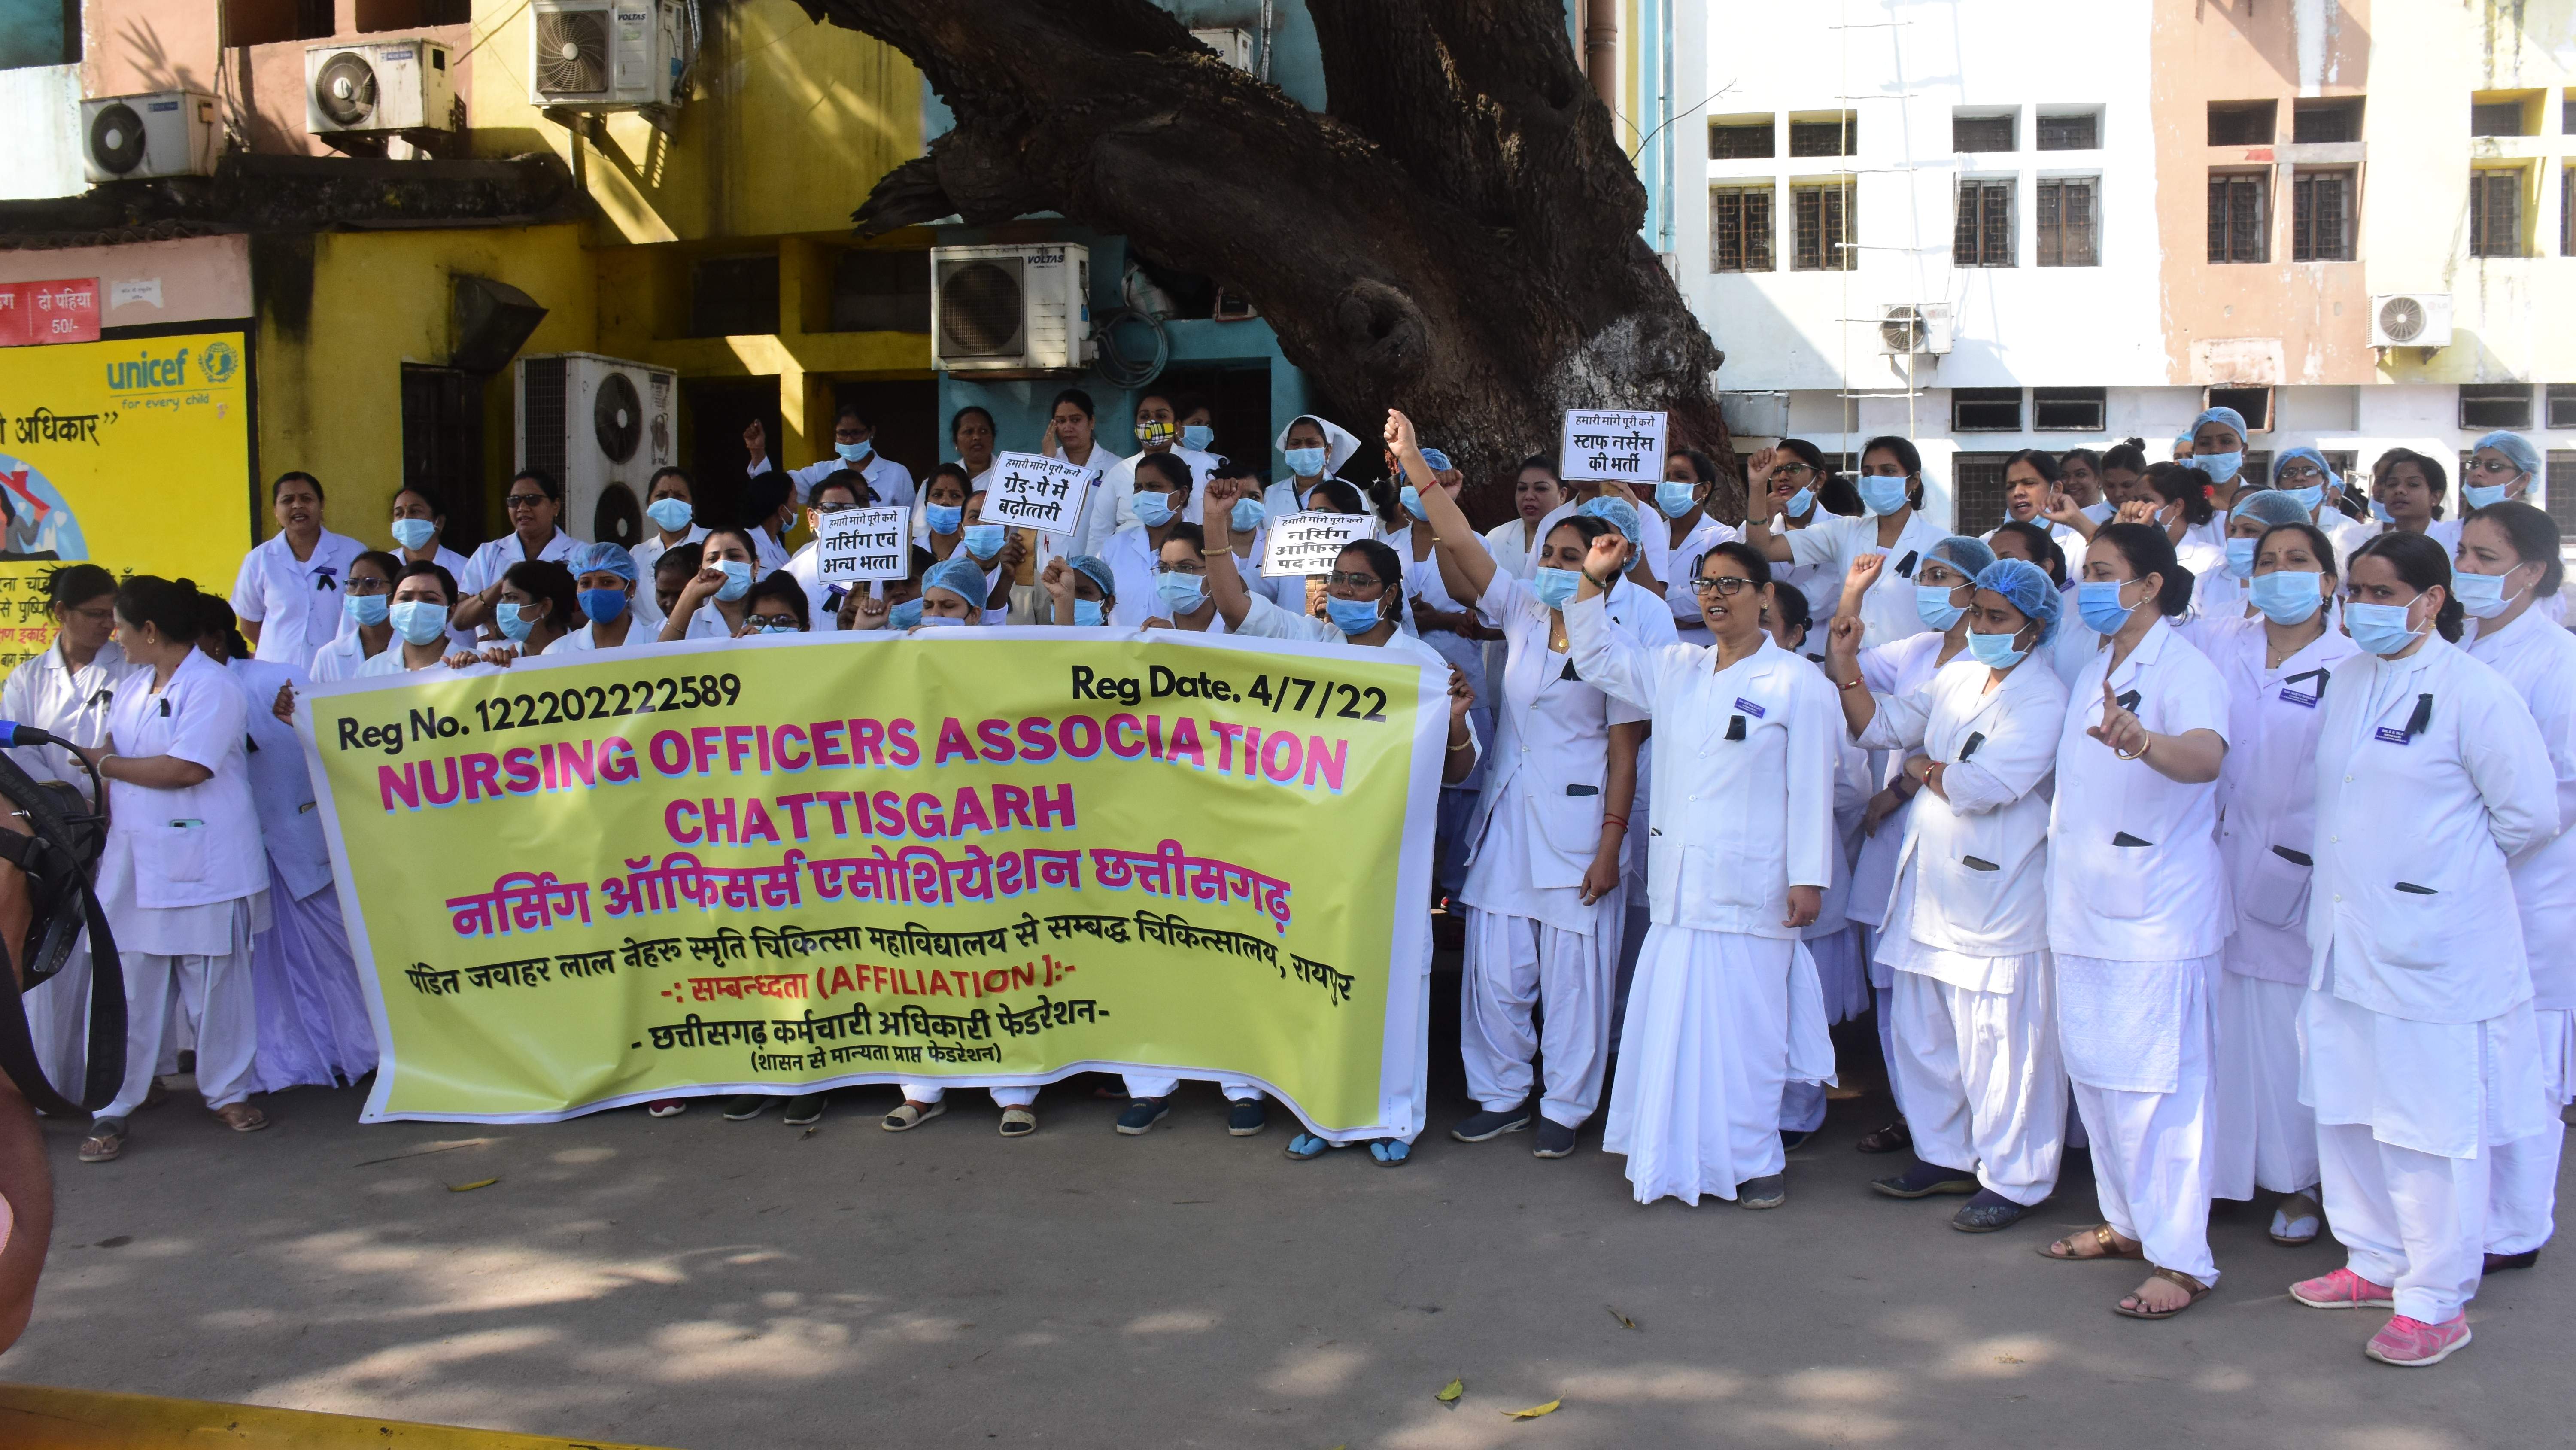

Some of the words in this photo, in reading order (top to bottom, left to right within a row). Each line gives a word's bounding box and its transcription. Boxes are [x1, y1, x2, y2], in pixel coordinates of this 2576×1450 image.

[1027, 255, 1064, 264] VOLTAS
[38, 289, 52, 311] दो
[55, 288, 91, 310] पहिया
[52, 319, 79, 334] 50/-
[107, 348, 189, 389] unicef
[122, 399, 140, 409] for
[146, 398, 179, 412] every
[185, 393, 209, 405] child
[1576, 414, 1601, 426] हमारी
[1602, 413, 1621, 426] मांगे
[1622, 414, 1637, 429] पूरी
[1638, 415, 1655, 428] करो
[1573, 434, 1610, 450] स्टाफ
[1612, 430, 1655, 452] नर्सेस
[1005, 458, 1030, 470] हमारी
[1030, 459, 1048, 471] मांगे
[1048, 464, 1064, 476] पूरी
[1063, 469, 1081, 477] करो
[1589, 452, 1609, 471] की
[1611, 453, 1641, 473] भर्ती
[1004, 471, 1050, 497] ग्रेड-पे
[1052, 478, 1069, 500] में
[829, 515, 848, 529] हमारी
[849, 512, 866, 525] मांगे
[867, 512, 881, 527] पूरी
[881, 510, 898, 523] करो
[1282, 516, 1307, 526] हमारी
[1308, 515, 1328, 523] मांगे
[1329, 517, 1345, 525] पूरी
[825, 529, 873, 551] नर्सिंग
[875, 526, 898, 547] एवं
[1287, 527, 1352, 541] नर्सिंग
[1275, 541, 1349, 555] ऑफिस
[823, 557, 857, 573] अन्य
[860, 555, 899, 570] भत्ता
[1277, 559, 1305, 569] पद
[1309, 558, 1336, 567] ना
[1072, 665, 1141, 706] Reg
[1149, 665, 1241, 703] Date.
[1248, 674, 1387, 723] 4/7/22
[337, 717, 404, 755] Reg
[410, 707, 470, 742] No.
[475, 673, 741, 732] 122202222589
[378, 736, 641, 814] NURSING
[649, 717, 921, 777] OFFICERS
[935, 713, 1349, 795] ASSOCIATION
[664, 783, 1078, 847] CHATTISGARH
[445, 871, 593, 939] नर्सिंग
[600, 848, 806, 919] ऑफिसर्स
[807, 844, 1083, 907] एसोशियेशन
[1089, 839, 1292, 938] छत्तीसगढ़
[405, 962, 461, 995] पंडित
[465, 957, 551, 989] जवाहर
[555, 949, 616, 979] लाल
[686, 927, 747, 968] स्मृति
[750, 924, 862, 960] चिकित्सा
[865, 921, 1009, 958] महाविद्यालय
[1012, 912, 1040, 948] से
[1044, 914, 1131, 944] सम्बद्ध
[1289, 952, 1355, 1006] रायपुर
[648, 1013, 768, 1052] छत्तीसगढ़
[772, 1002, 872, 1046] कर्मचारी
[878, 1004, 990, 1040] अधिकारी
[751, 1050, 804, 1073] (शासन
[807, 1046, 826, 1069] से
[830, 1043, 890, 1065] मान्यता
[893, 1045, 923, 1064] प्राप्त
[928, 1040, 1002, 1064] फेडरेशन)
